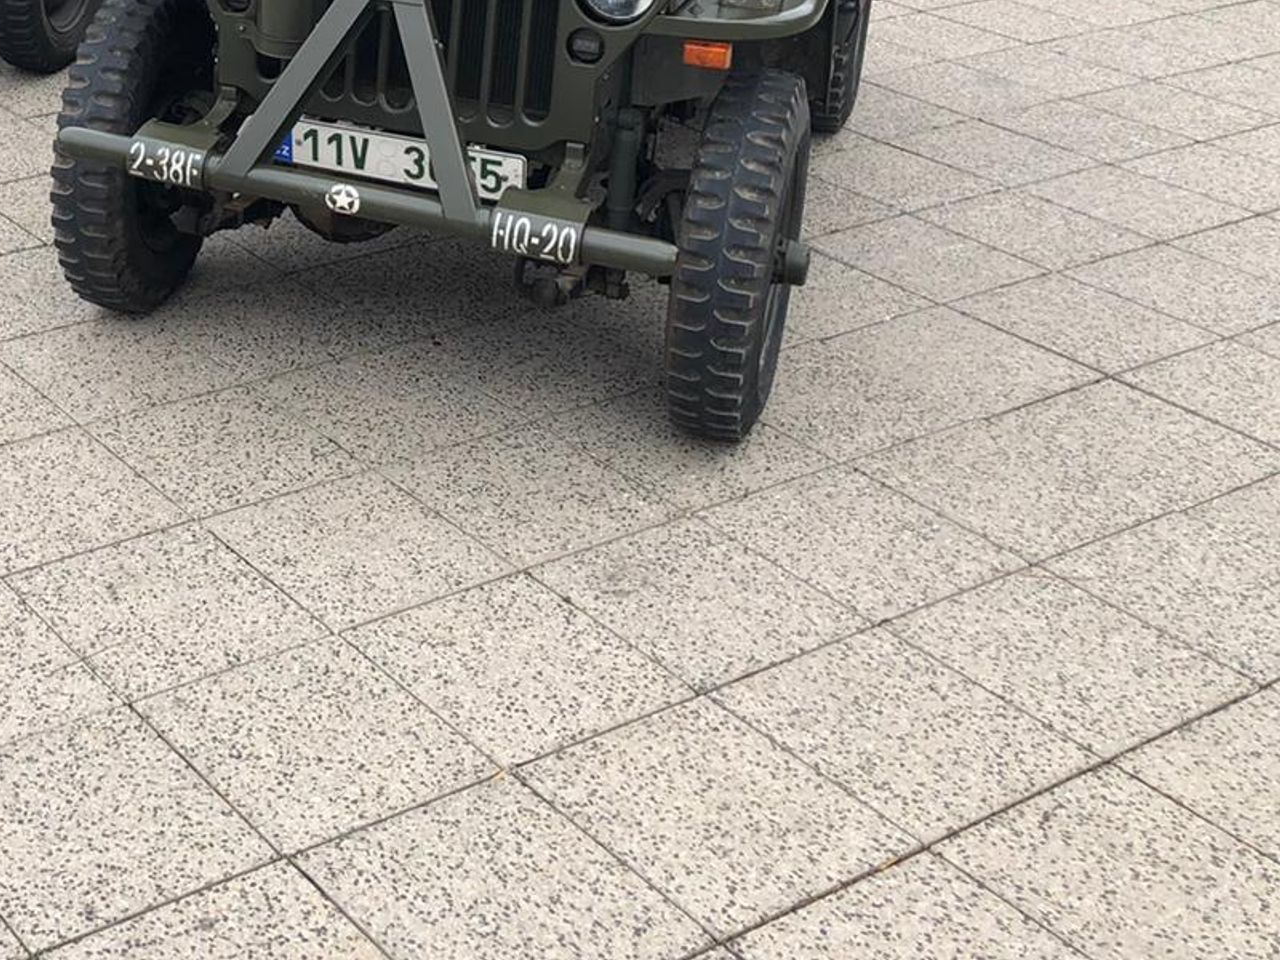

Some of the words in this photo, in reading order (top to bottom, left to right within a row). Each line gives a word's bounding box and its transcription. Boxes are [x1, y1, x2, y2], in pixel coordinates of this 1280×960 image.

[128, 141, 202, 186] 2-38F
[302, 128, 369, 171] 11V
[403, 145, 503, 193] 35
[492, 211, 577, 264] HQ-20
